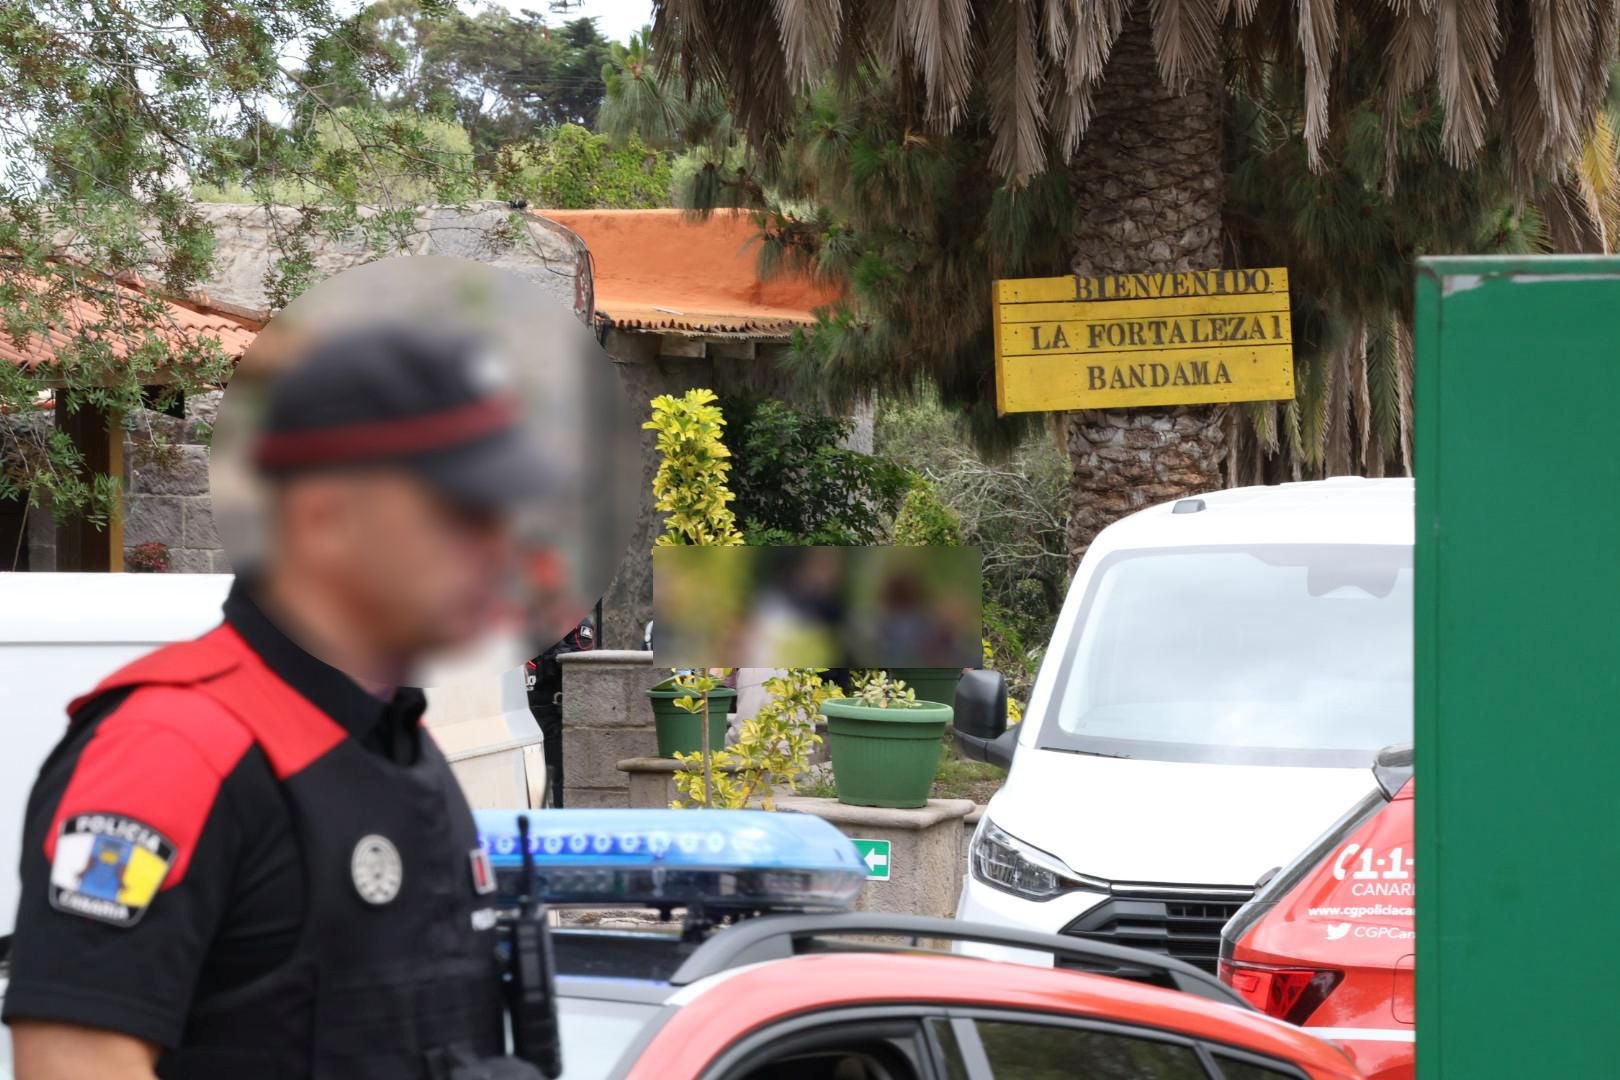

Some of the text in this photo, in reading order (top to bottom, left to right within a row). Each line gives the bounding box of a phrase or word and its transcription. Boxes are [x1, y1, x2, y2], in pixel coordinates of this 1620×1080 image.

[1072, 269, 1271, 301] BIENVENIDO
[1031, 324, 1070, 350] LA
[1087, 315, 1266, 349] FORTALEZA
[1087, 360, 1232, 390] BANDAMA
[1308, 904, 1415, 918] www.cgpoliciaca
